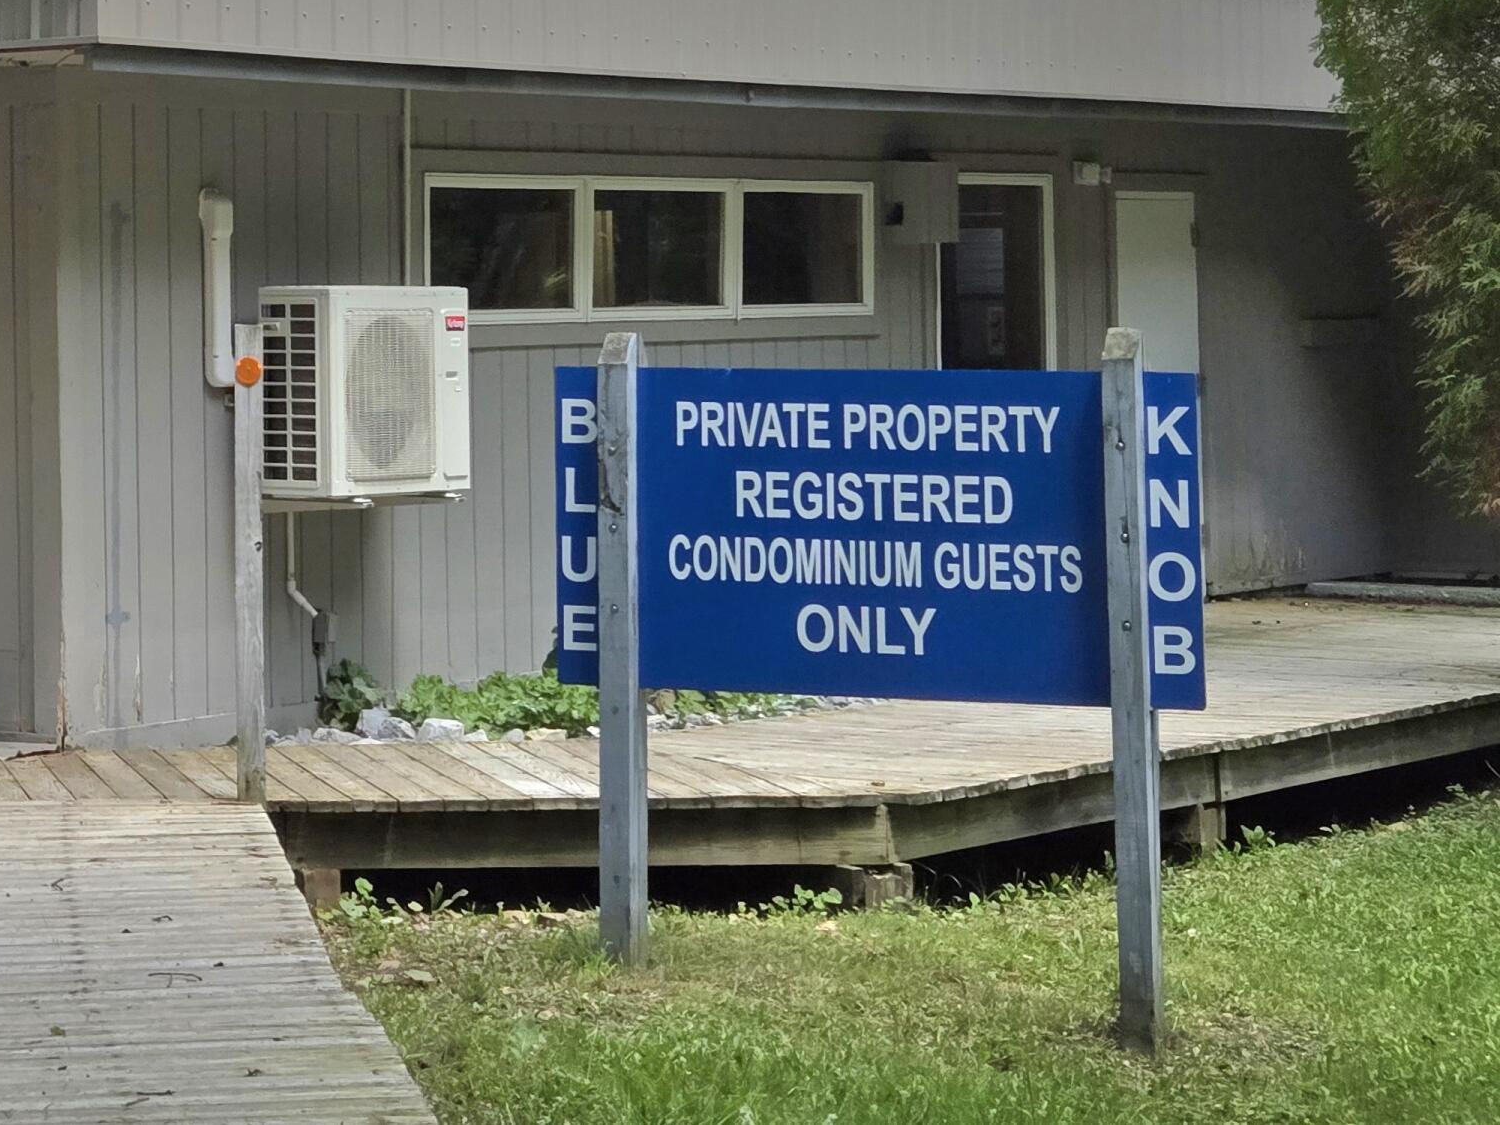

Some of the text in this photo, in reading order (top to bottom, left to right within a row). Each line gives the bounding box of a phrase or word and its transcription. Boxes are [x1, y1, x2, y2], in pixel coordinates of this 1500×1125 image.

[675, 401, 1060, 453] PRIVATE PROPERTY
[561, 398, 598, 651] BLUE
[735, 470, 1013, 524] REGISTERED
[668, 534, 1083, 593] CONDOMINIUM GUESTS
[1146, 405, 1197, 675] KNOB
[796, 603, 937, 656] ONLY
